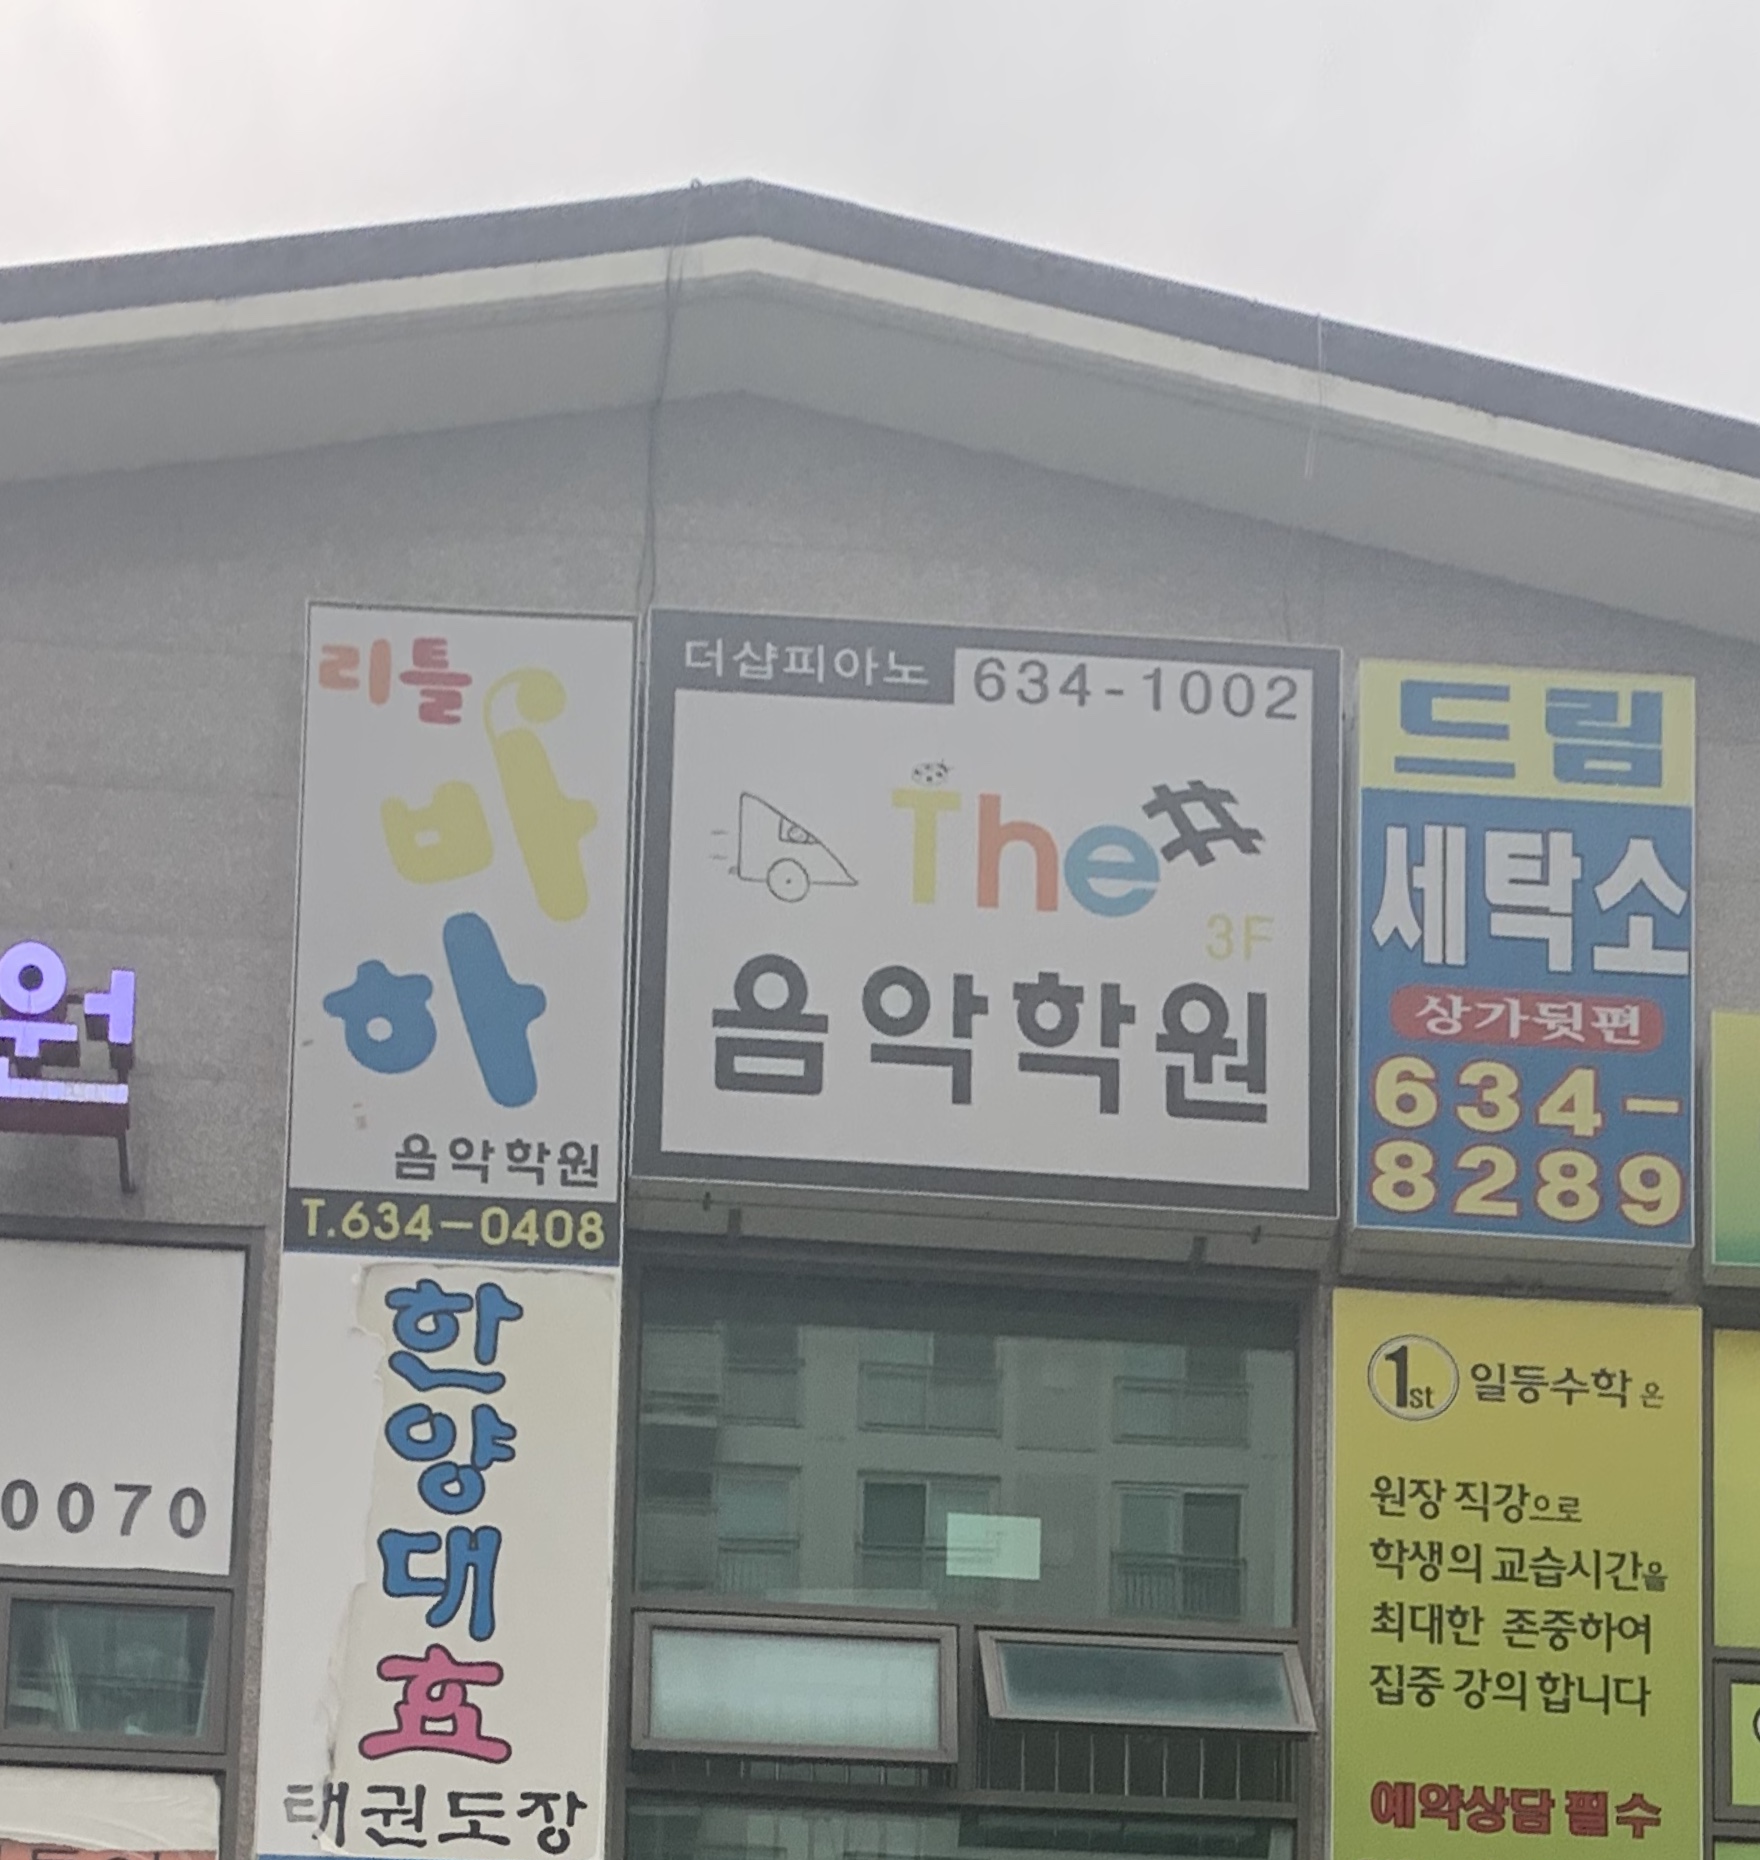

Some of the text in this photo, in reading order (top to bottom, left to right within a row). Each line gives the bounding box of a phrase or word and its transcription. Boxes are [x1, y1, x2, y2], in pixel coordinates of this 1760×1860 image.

[318, 636, 473, 725] 리틀
[685, 638, 929, 687] 더샵피아노
[972, 656, 1299, 720] 634-1002
[1394, 680, 1663, 788] 드림
[1372, 824, 1690, 975] 세탁소
[1206, 914, 1274, 961] 3F
[713, 953, 1267, 1123] 음악학원
[1415, 994, 1642, 1046] 상가뒷편
[1373, 1055, 1681, 1138] 634-
[394, 1132, 600, 1190] 음악학원
[1371, 1139, 1682, 1226] 8289
[301, 1196, 606, 1251] T.634-0408
[1385, 1344, 1435, 1409] 1st
[1370, 1475, 1583, 1524] 원장 직강으로
[1369, 1537, 1668, 1592] 학생의 교습시간을
[1371, 1601, 1651, 1655] 최대한 존중하여
[1370, 1664, 1444, 1708] 집중
[283, 1781, 587, 1855] 태권도장
[1369, 1779, 1662, 1838] 예약상담 필수
